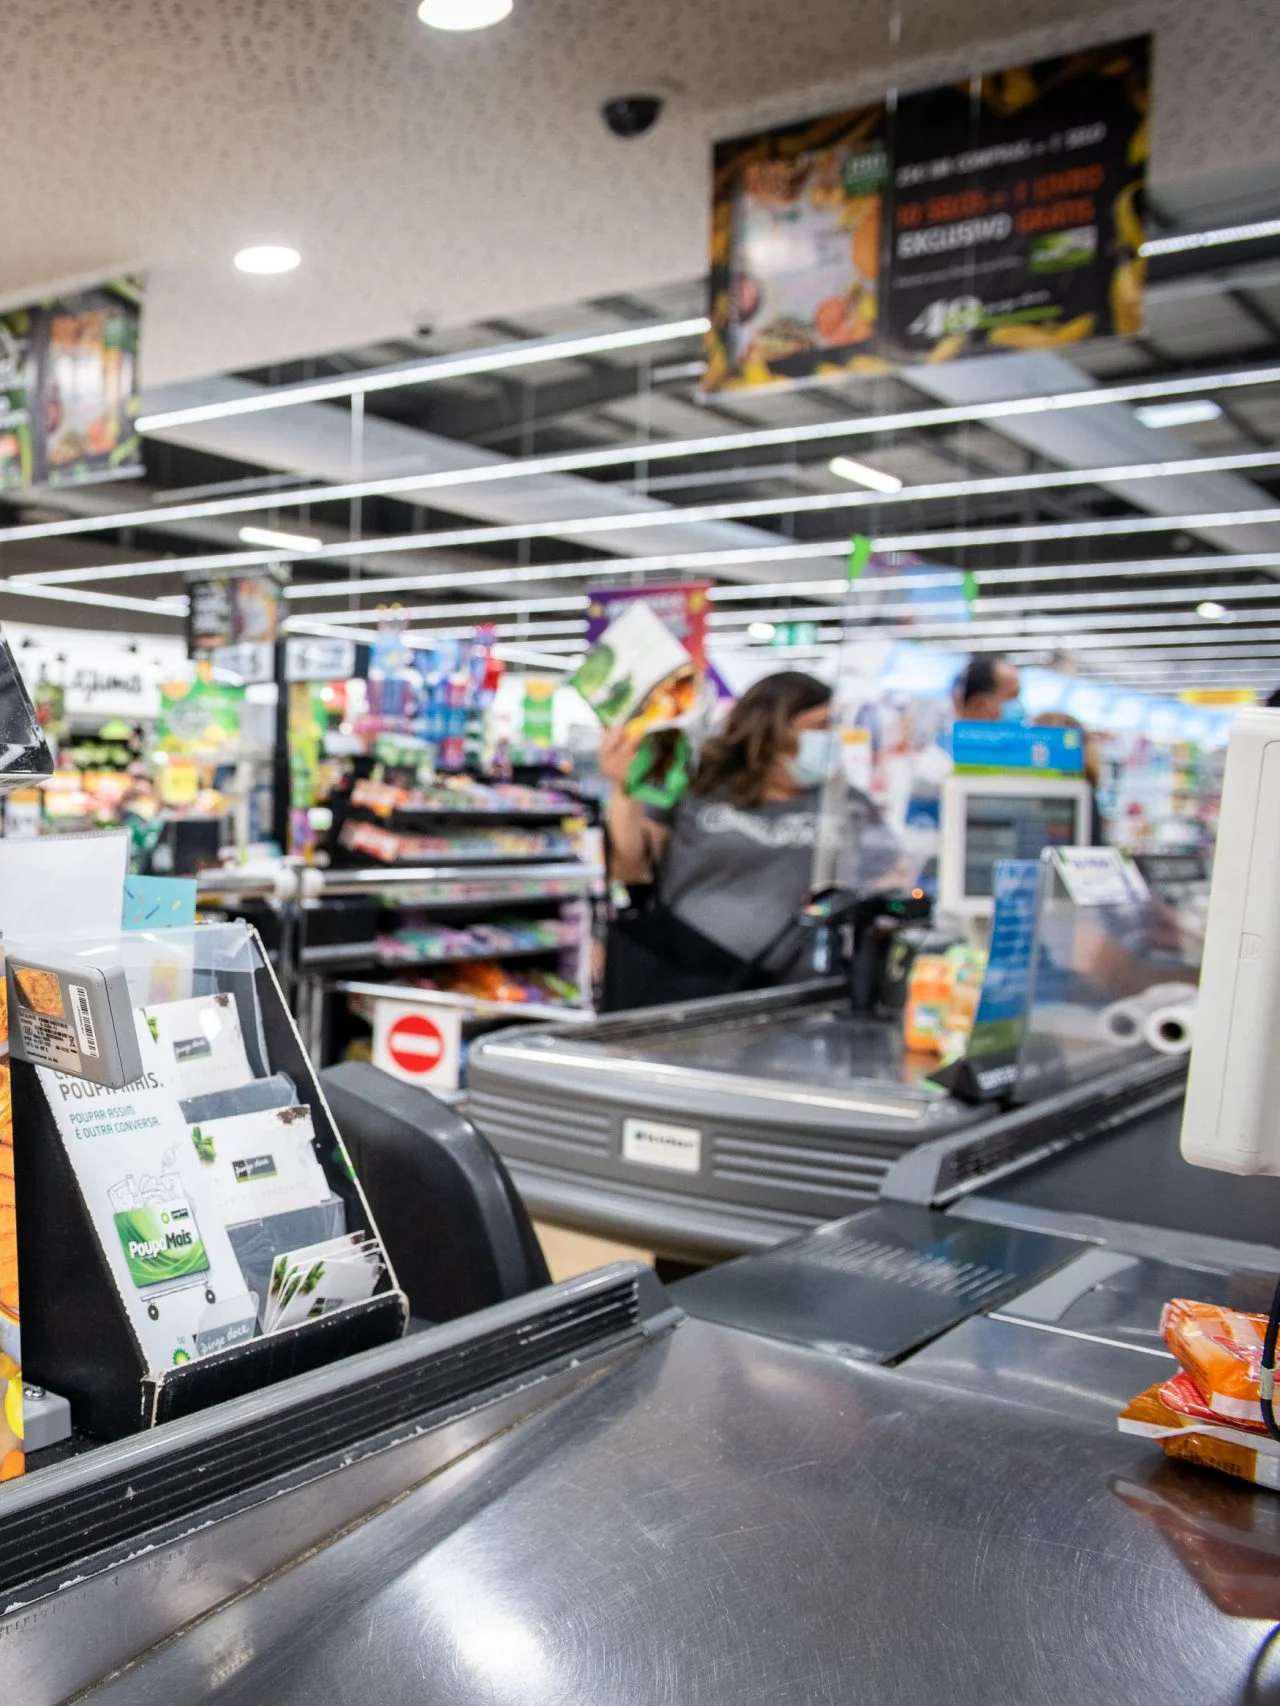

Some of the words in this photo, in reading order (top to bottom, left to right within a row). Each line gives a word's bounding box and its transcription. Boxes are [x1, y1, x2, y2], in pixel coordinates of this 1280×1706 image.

[59, 1082, 116, 1101] POUP
[69, 1109, 106, 1125] POUPAR
[107, 1105, 136, 1118] ASSIM
[75, 1127, 82, 1140] É
[82, 1124, 113, 1138] OUTRA
